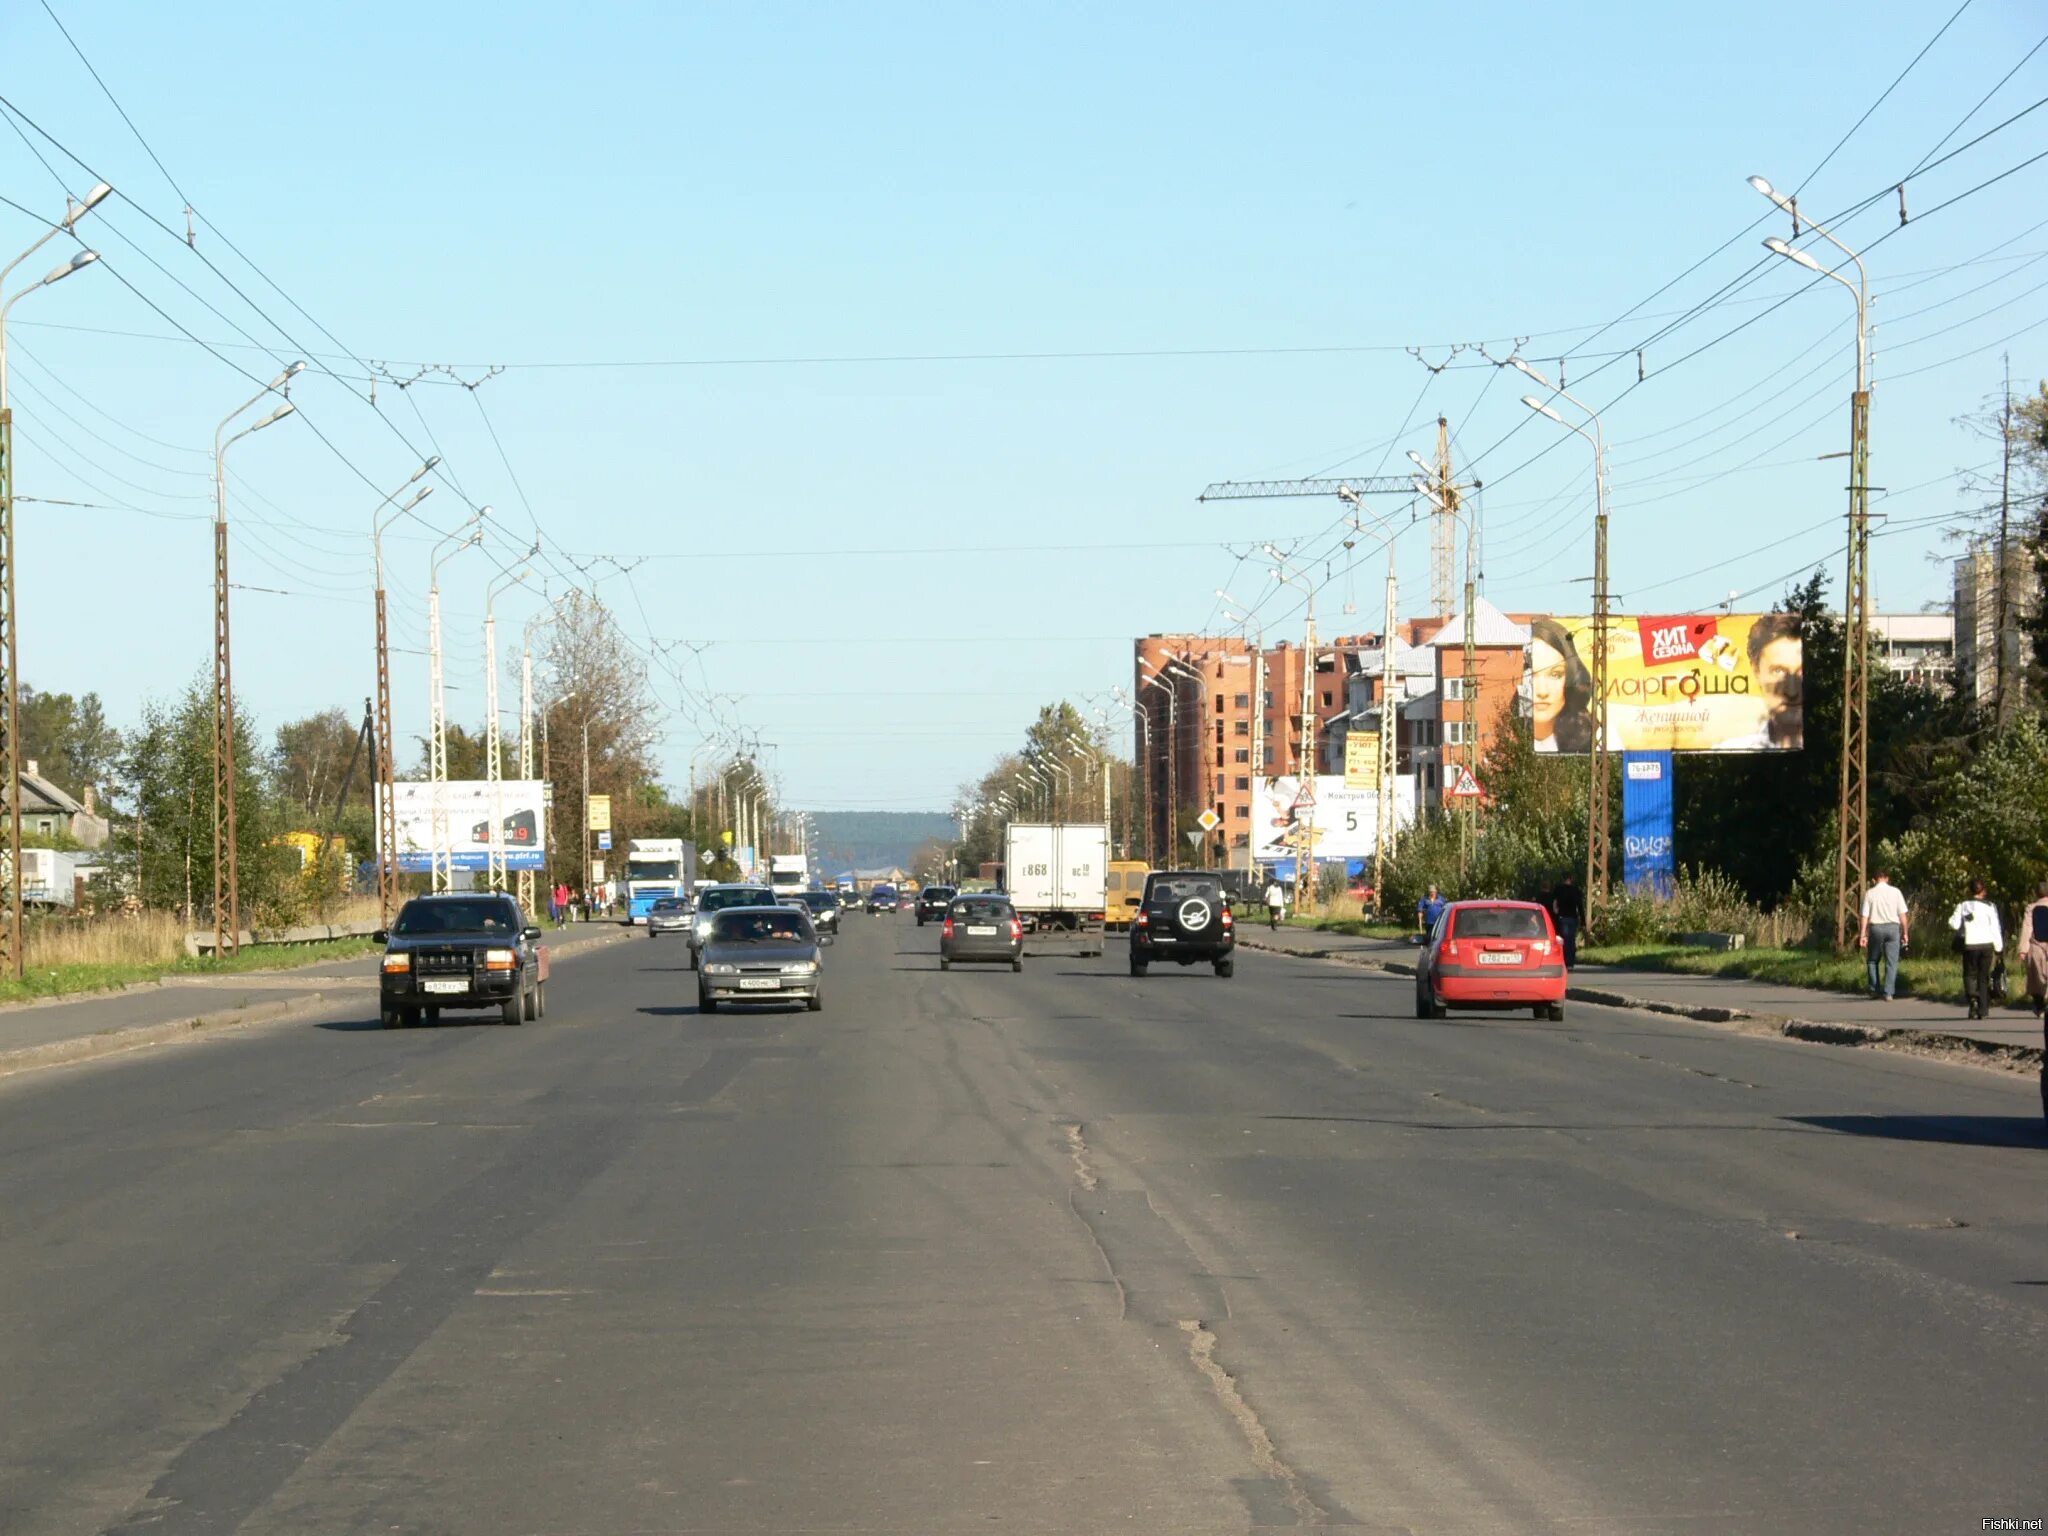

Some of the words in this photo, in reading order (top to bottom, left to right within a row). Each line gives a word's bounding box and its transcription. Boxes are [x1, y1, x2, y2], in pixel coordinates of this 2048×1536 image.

[1651, 625, 1687, 648] ХИТ
[1652, 642, 1695, 660] СЕЗОНА
[1346, 811, 1358, 831] 5
